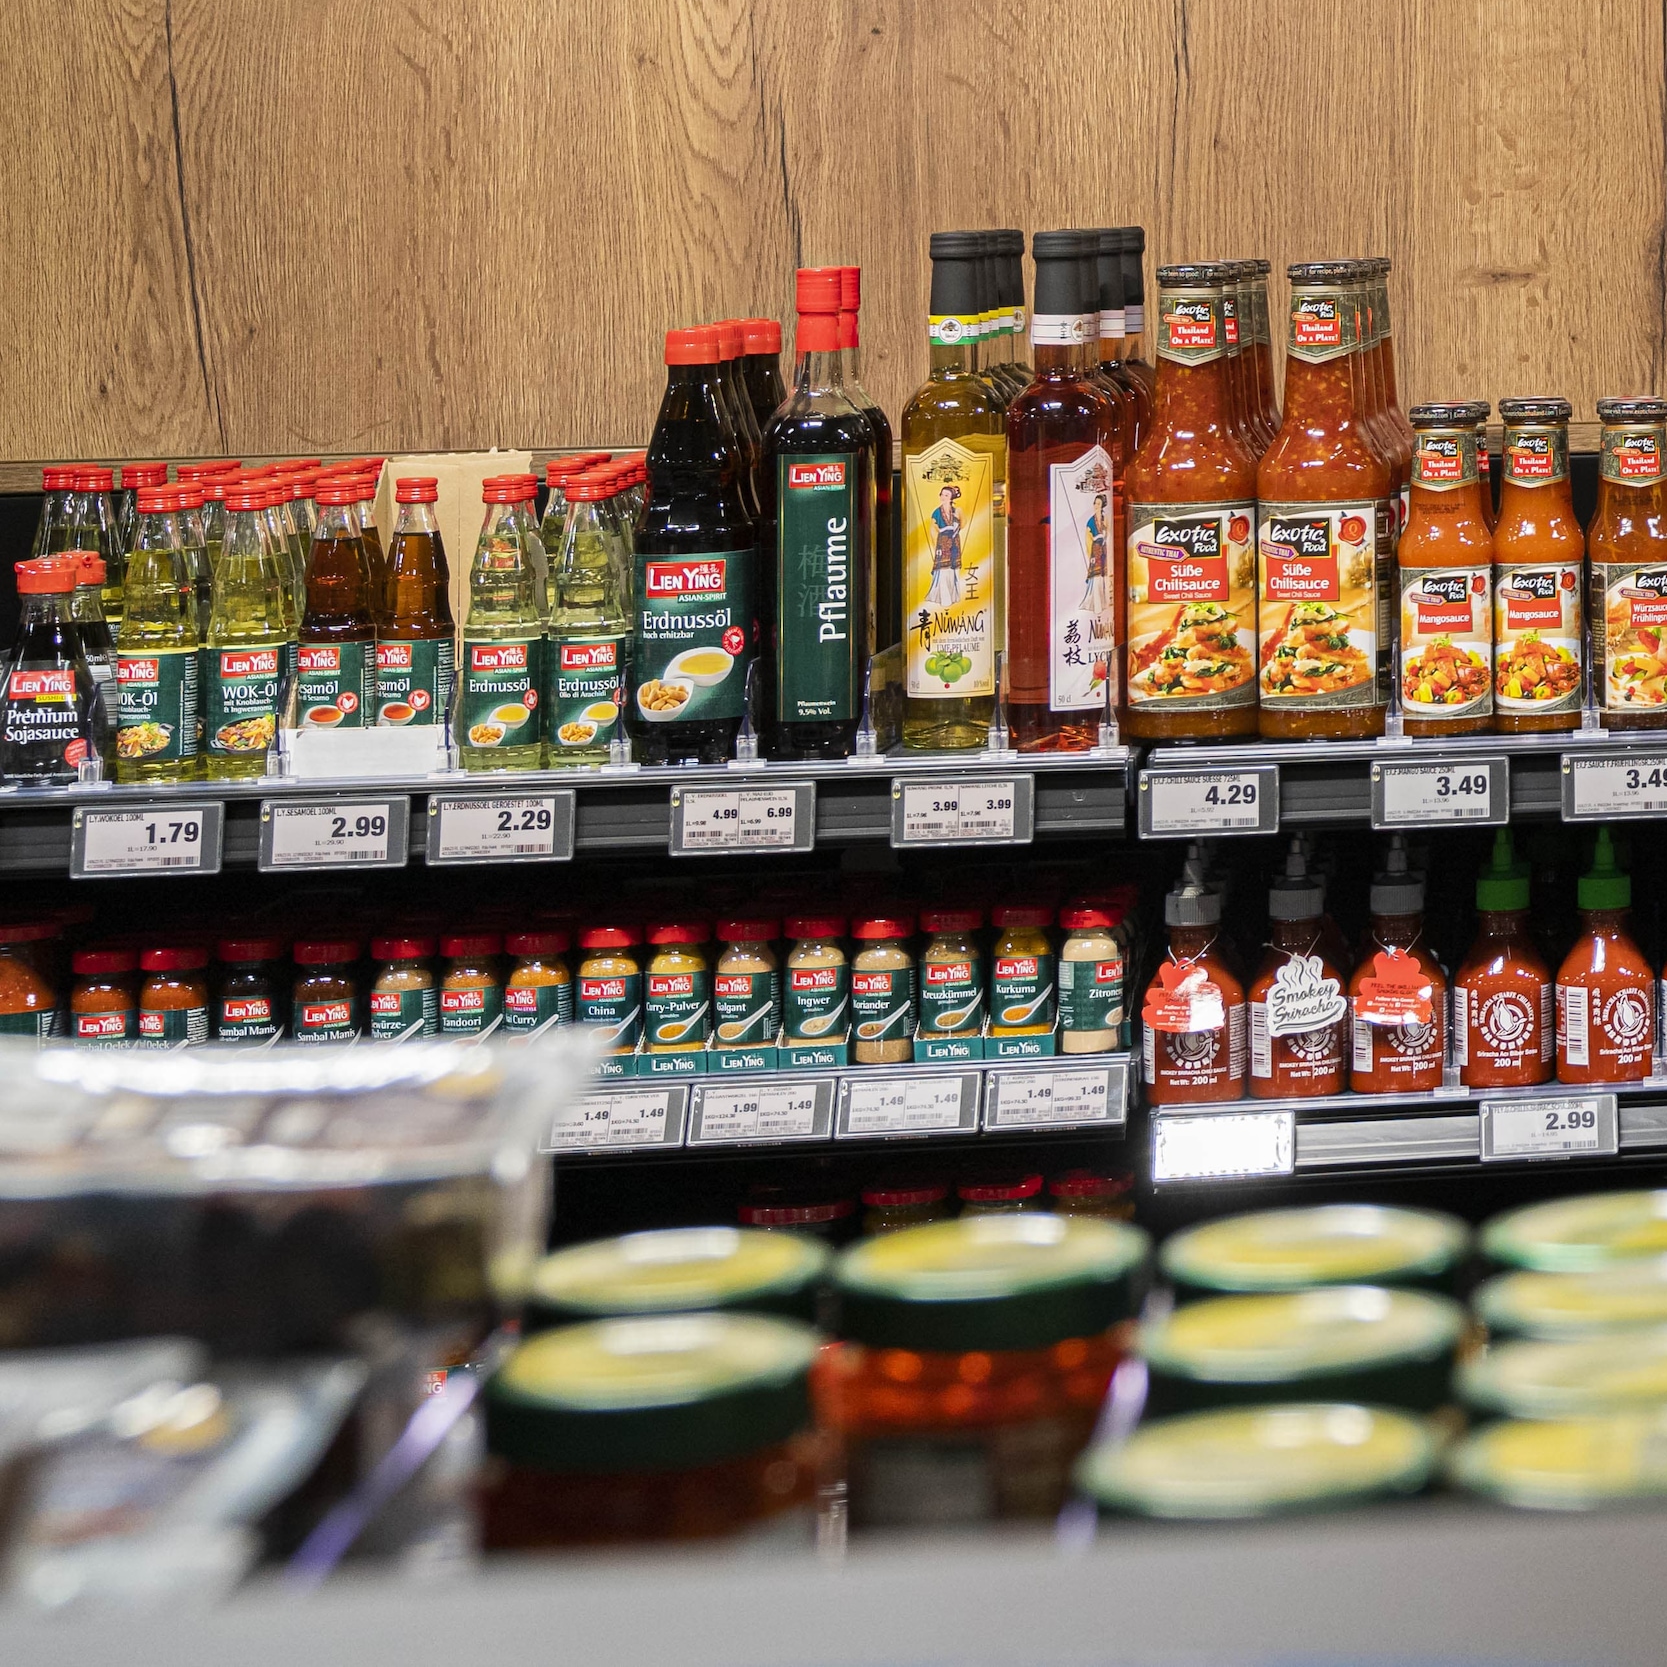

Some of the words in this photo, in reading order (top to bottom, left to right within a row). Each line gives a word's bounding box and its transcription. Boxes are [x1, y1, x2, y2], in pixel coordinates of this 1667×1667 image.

[1177, 326, 1209, 335] Thailand
[1156, 524, 1217, 543] Exotic
[1194, 541, 1218, 553] Food
[1171, 564, 1203, 577] Süße
[649, 567, 682, 589] LIEN
[683, 567, 722, 588] YING
[819, 517, 847, 643] Pflaume
[1154, 578, 1220, 590] Chilisauce
[678, 592, 727, 602] ASIAN-SPIRIT
[643, 609, 731, 630] Erdnussöl
[1419, 613, 1470, 624] Mangosauce
[1508, 609, 1559, 619] Mangosauce
[643, 631, 658, 639] hoch
[660, 631, 694, 639] erhitzbar
[937, 642, 980, 653] UME-PFLAUME
[222, 683, 278, 699] WOK-Öl
[469, 678, 531, 693] Erdnussöl
[7, 709, 78, 723] Premium
[6, 726, 79, 744] Sojasauce
[1436, 775, 1488, 795] 3.49
[1205, 784, 1256, 805] 4.29
[933, 801, 958, 812] 3.99
[986, 799, 1011, 810] 3.99
[713, 809, 737, 819] 4.99
[766, 807, 792, 818] 6.99
[498, 810, 551, 831] 2.29
[331, 816, 385, 837] 2.99
[145, 822, 199, 844] 1.79
[923, 989, 977, 999] Kreuzkümmel
[996, 985, 1036, 993] Kurkuma
[1272, 983, 1336, 1008] Smokey
[646, 1001, 700, 1012] Curry-Pulver
[797, 996, 830, 1007] Ingwer
[853, 1000, 890, 1009] Koriander
[588, 1006, 615, 1016] China
[717, 1003, 746, 1013] Galgant
[1272, 1000, 1343, 1025] Sriracha
[442, 1015, 482, 1028] Tandoori
[219, 1028, 246, 1038] Sambal
[248, 1025, 277, 1035] Manis
[1494, 1058, 1510, 1067] 200
[1027, 1088, 1051, 1098] 1.49
[1081, 1085, 1104, 1095] 1.49
[879, 1096, 903, 1106] 1.49
[934, 1094, 958, 1103] 1.49
[733, 1103, 757, 1112] 1.99
[788, 1100, 812, 1109] 1.49
[584, 1111, 609, 1121] 1.49
[640, 1108, 664, 1118] 1.49
[1545, 1111, 1595, 1130] 2.99
